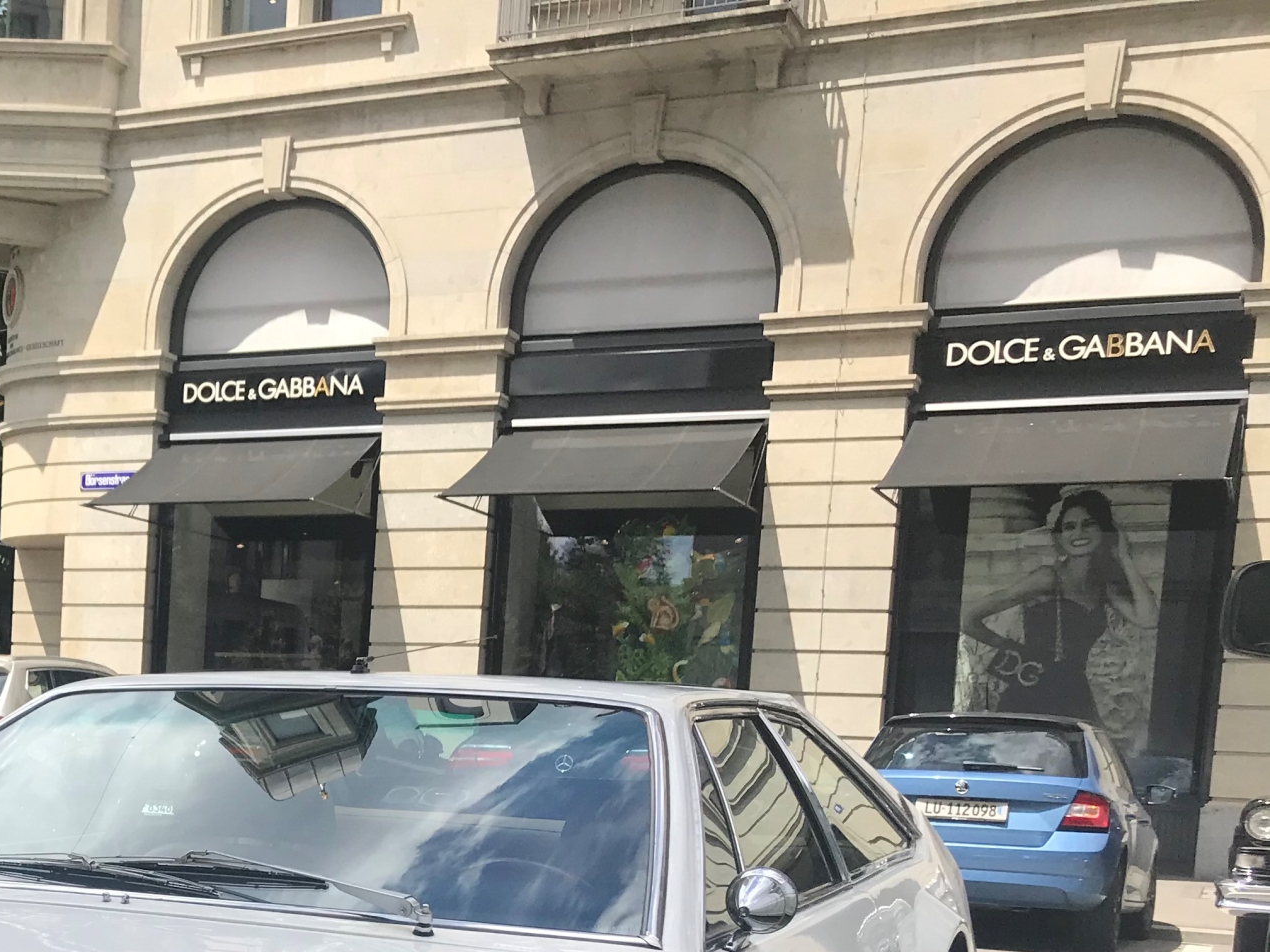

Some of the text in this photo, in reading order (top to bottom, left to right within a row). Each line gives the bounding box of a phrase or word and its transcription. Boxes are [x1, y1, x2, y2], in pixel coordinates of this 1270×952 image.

[945, 328, 1216, 367] DOLCE & GABBANA
[183, 373, 364, 404] DOLCE & GABBANA
